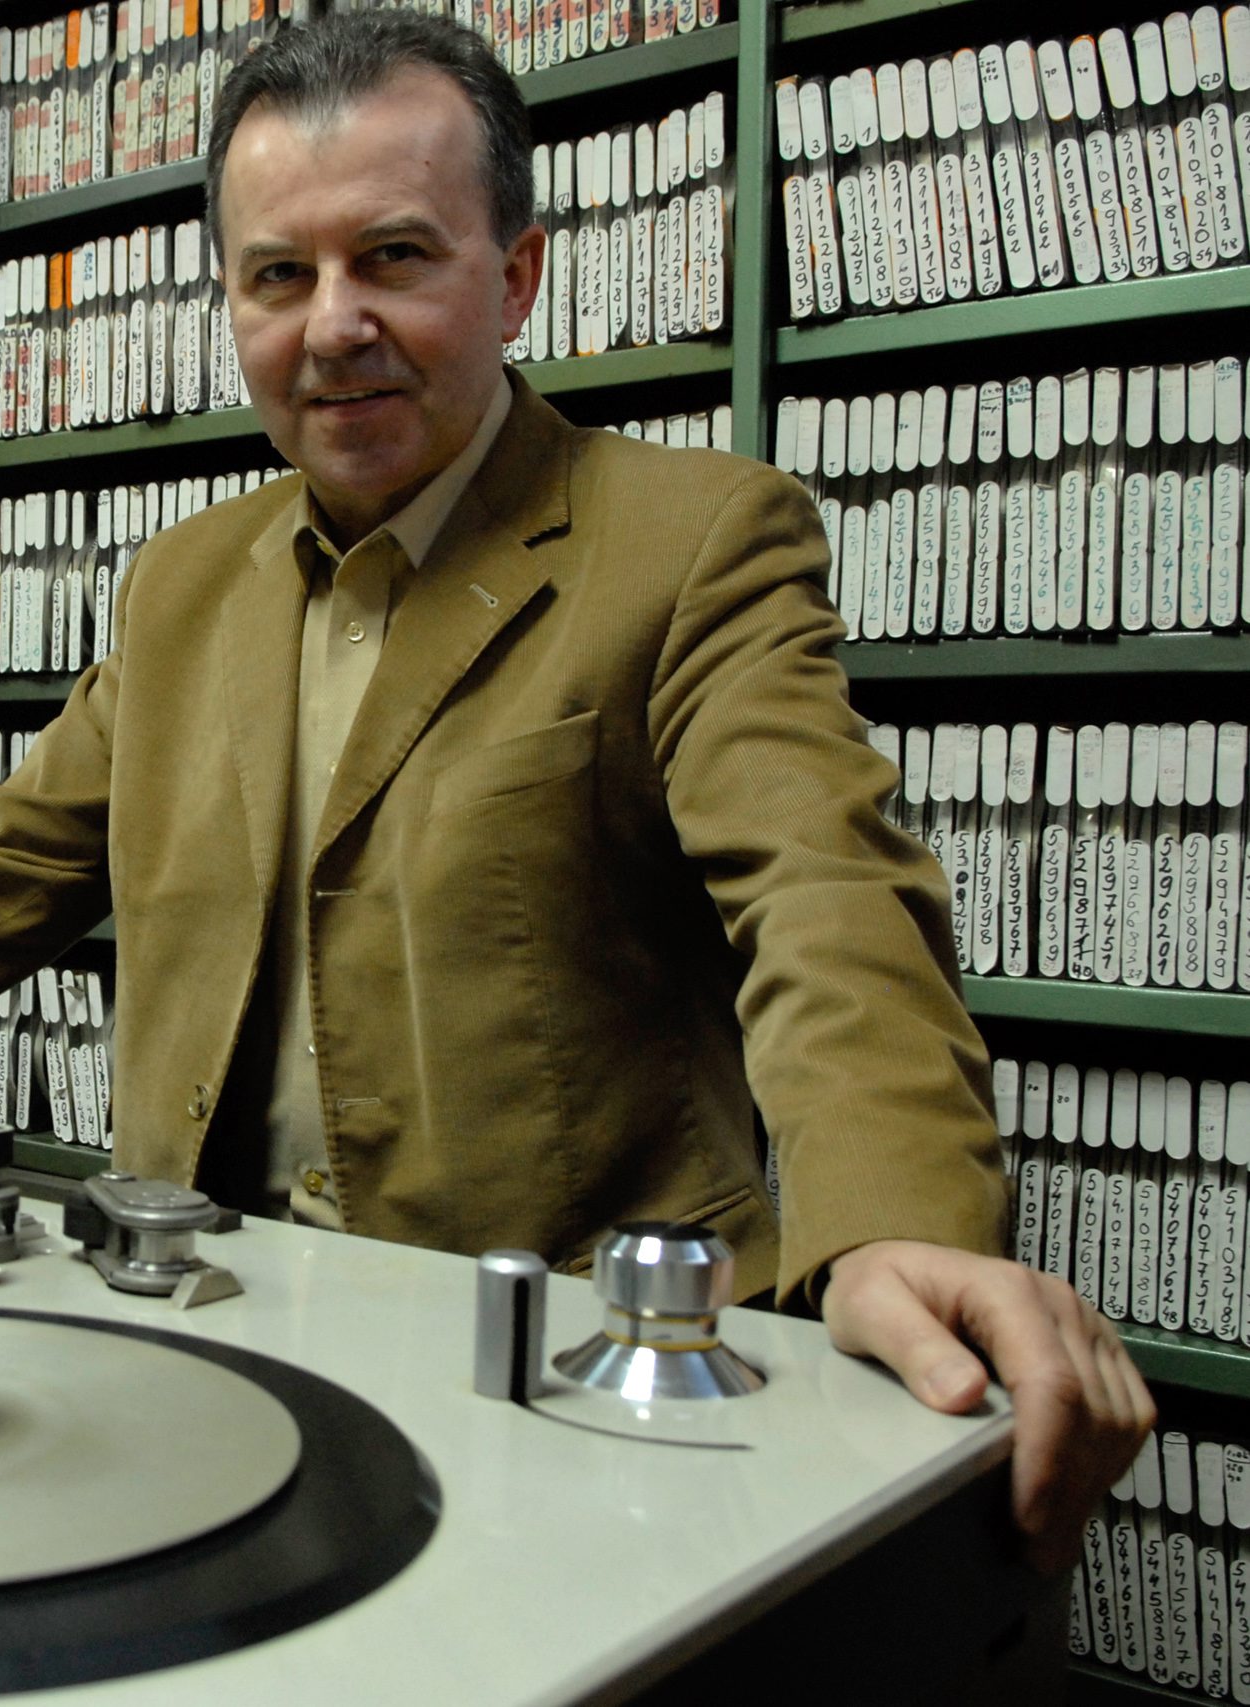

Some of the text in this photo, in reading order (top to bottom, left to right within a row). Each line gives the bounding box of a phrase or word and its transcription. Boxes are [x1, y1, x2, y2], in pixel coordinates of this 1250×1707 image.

[838, 133, 853, 149] 2
[862, 127, 871, 143] 1
[711, 148, 719, 162] 5
[783, 139, 793, 156] 4
[811, 139, 822, 155] 3
[671, 166, 681, 181] 7
[694, 159, 704, 173] 6
